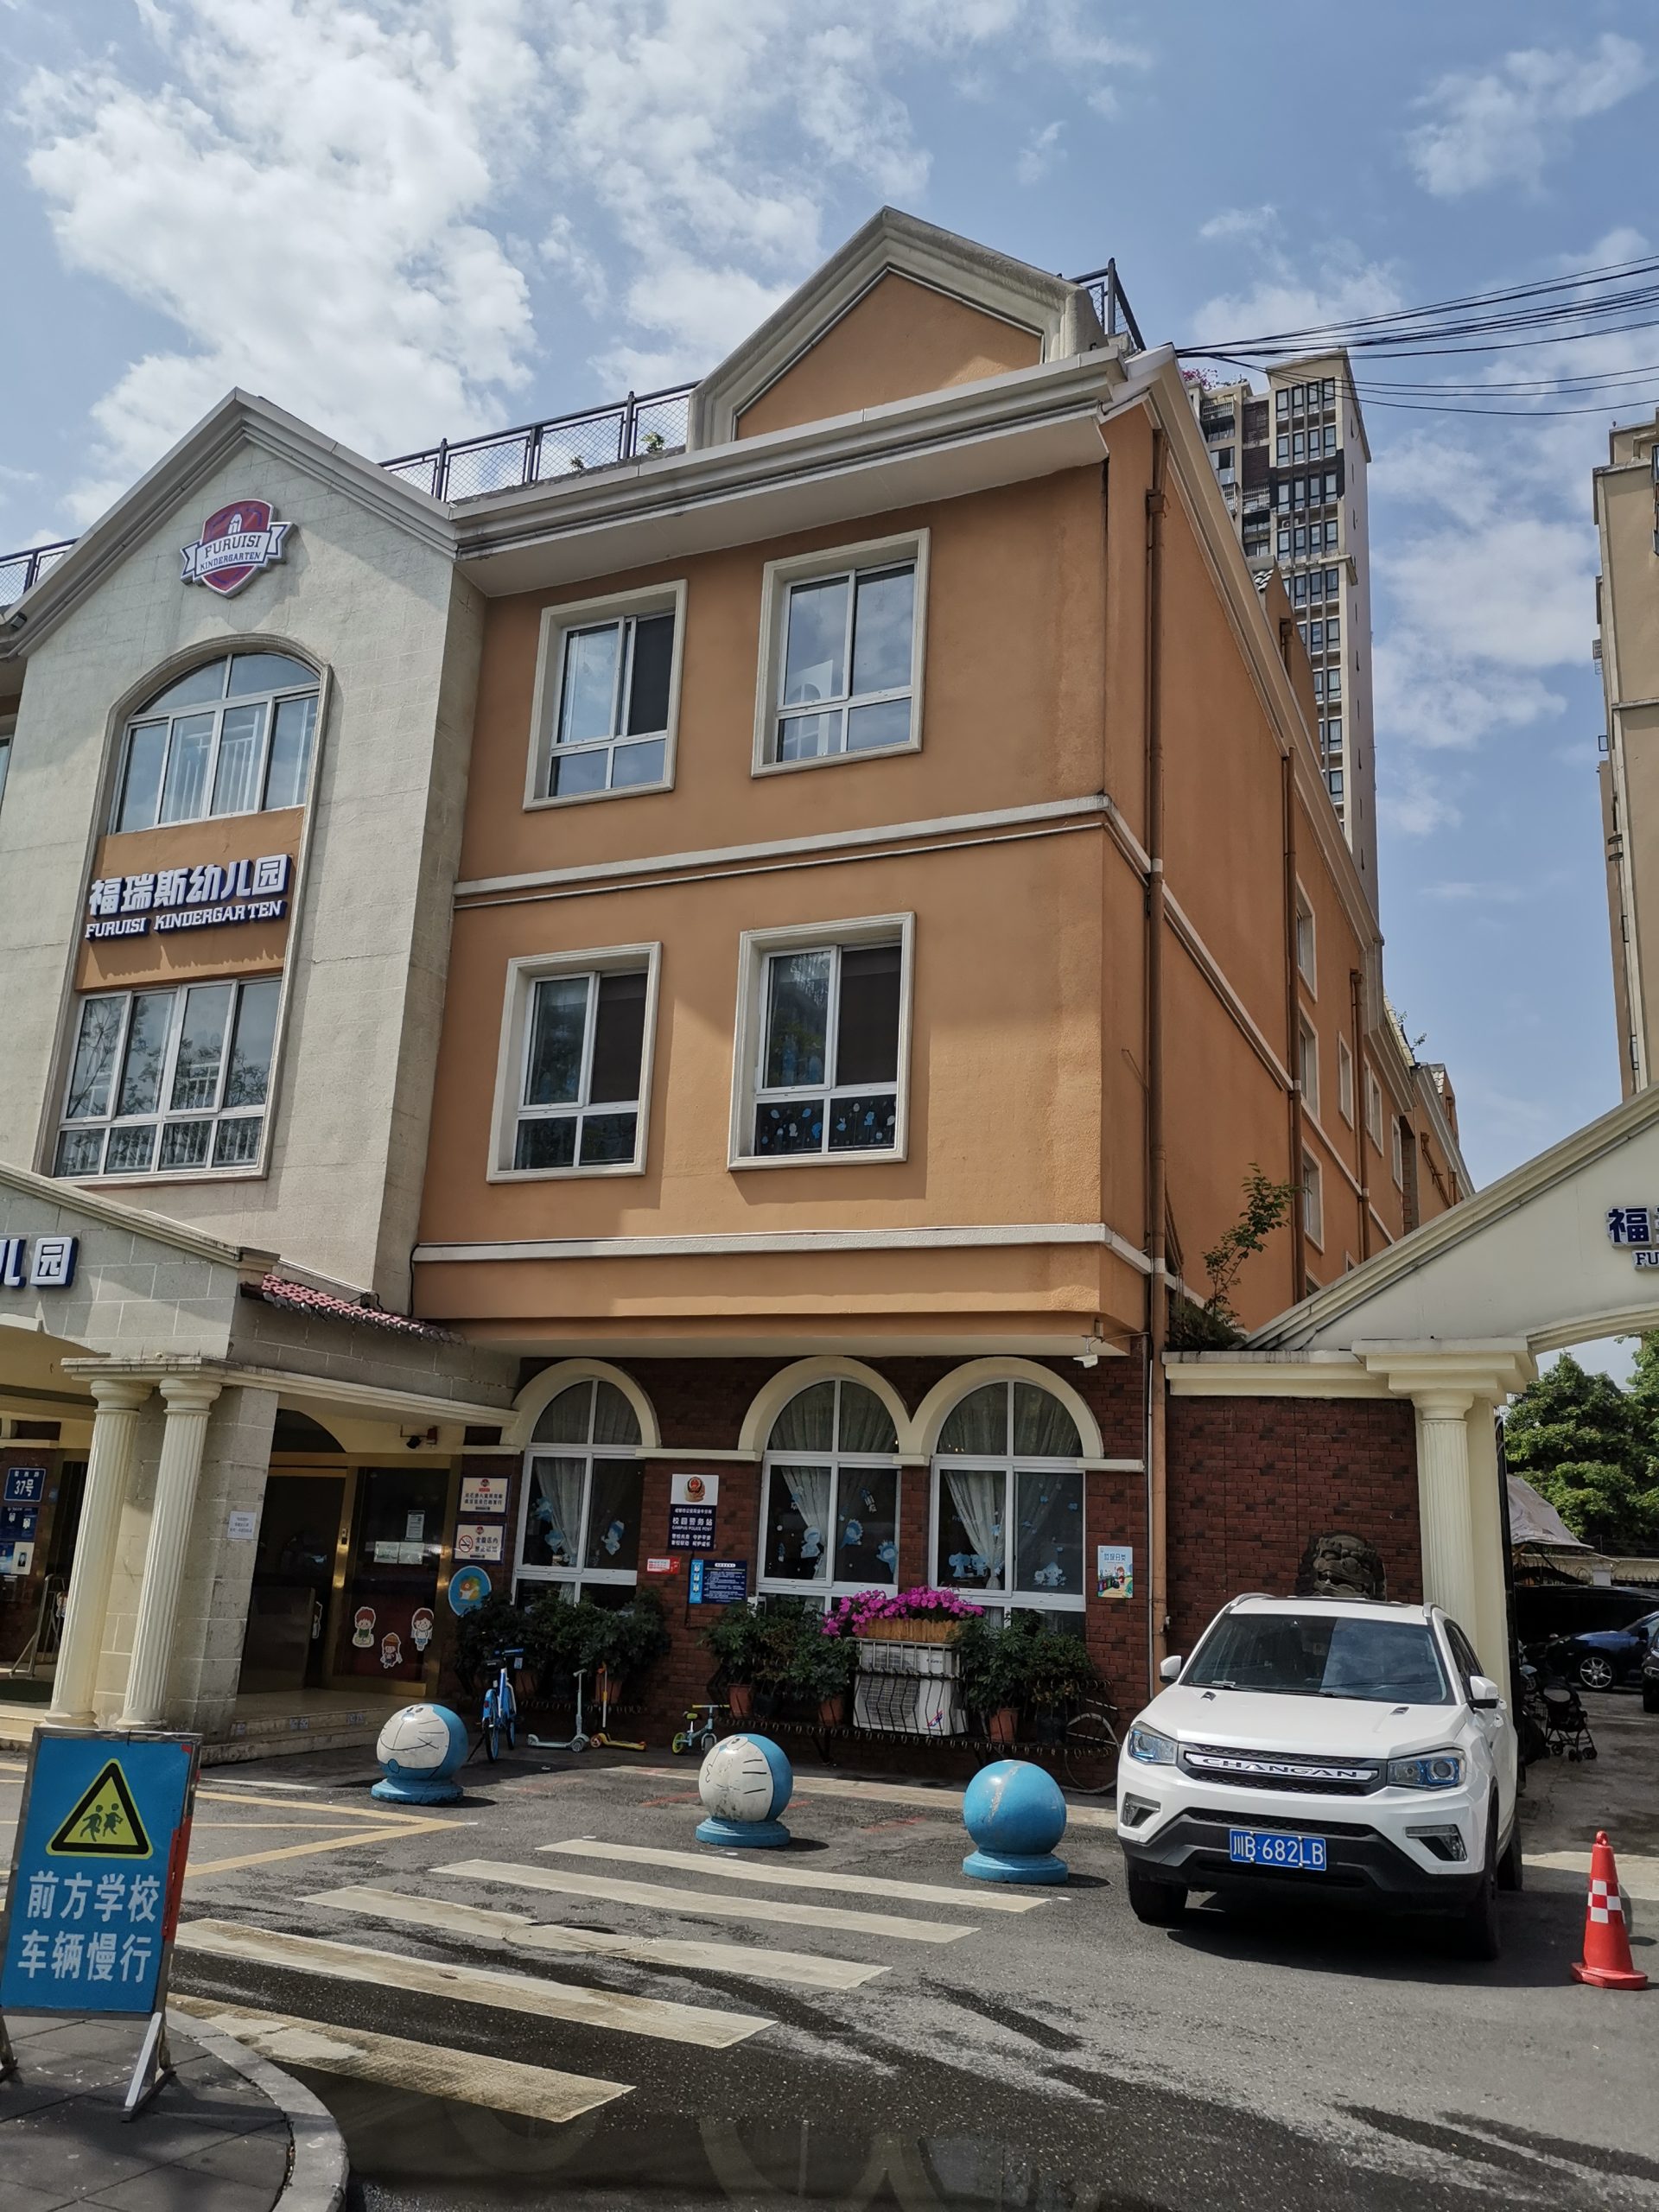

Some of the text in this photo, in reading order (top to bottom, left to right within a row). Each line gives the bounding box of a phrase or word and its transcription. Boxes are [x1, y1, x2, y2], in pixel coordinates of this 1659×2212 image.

[200, 551, 261, 571] KINDERGARTEN
[204, 534, 262, 559] FURUISI
[89, 854, 289, 917] 福瑞斯幼儿园
[85, 899, 284, 939] FURUISI KINDERGARTEN
[1606, 1206, 1659, 1244] 福
[14, 1478, 35, 1497] 37号
[672, 1516, 713, 1526] 校园警务站
[1202, 1758, 1357, 1778] CHANGAN
[27, 1870, 162, 1924] 前方学校
[17, 1929, 153, 1984] 车辆慢行
